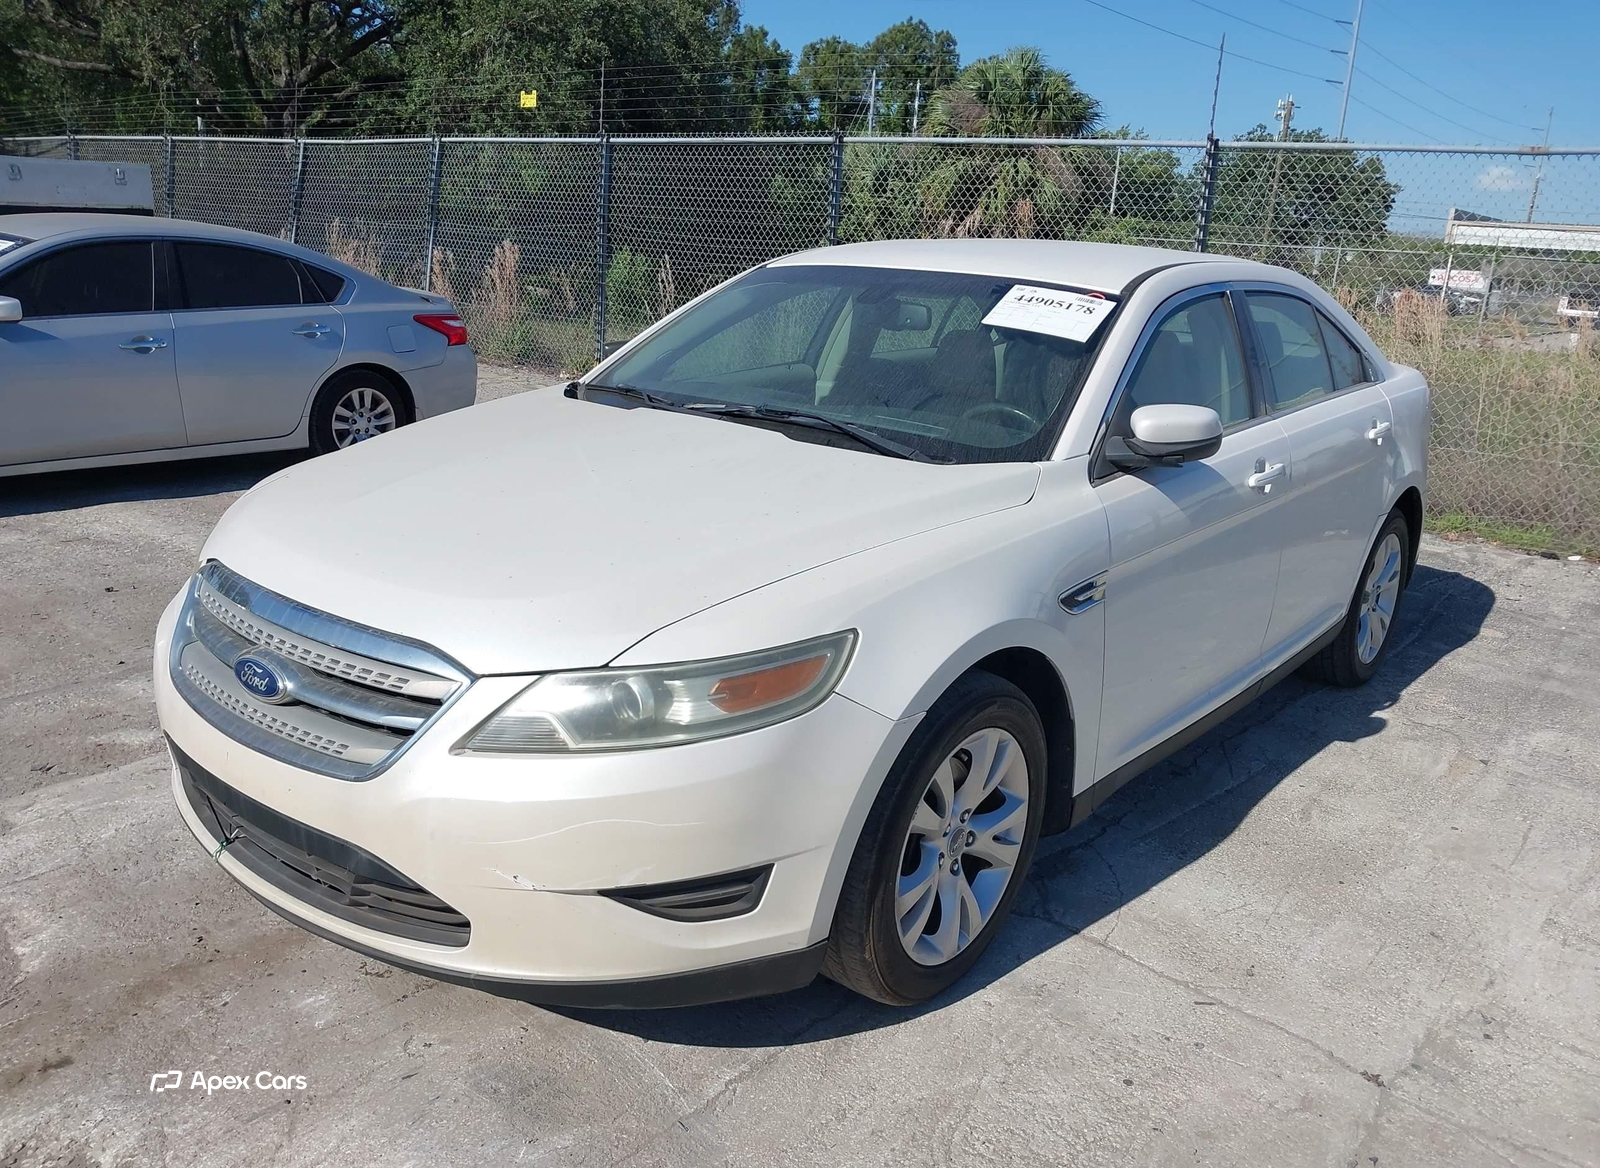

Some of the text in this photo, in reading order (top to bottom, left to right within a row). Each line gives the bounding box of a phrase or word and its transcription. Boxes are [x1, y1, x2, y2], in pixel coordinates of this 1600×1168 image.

[1436, 274, 1480, 283] ACOSA
[1014, 294, 1096, 315] 44905178
[241, 662, 269, 691] Ford
